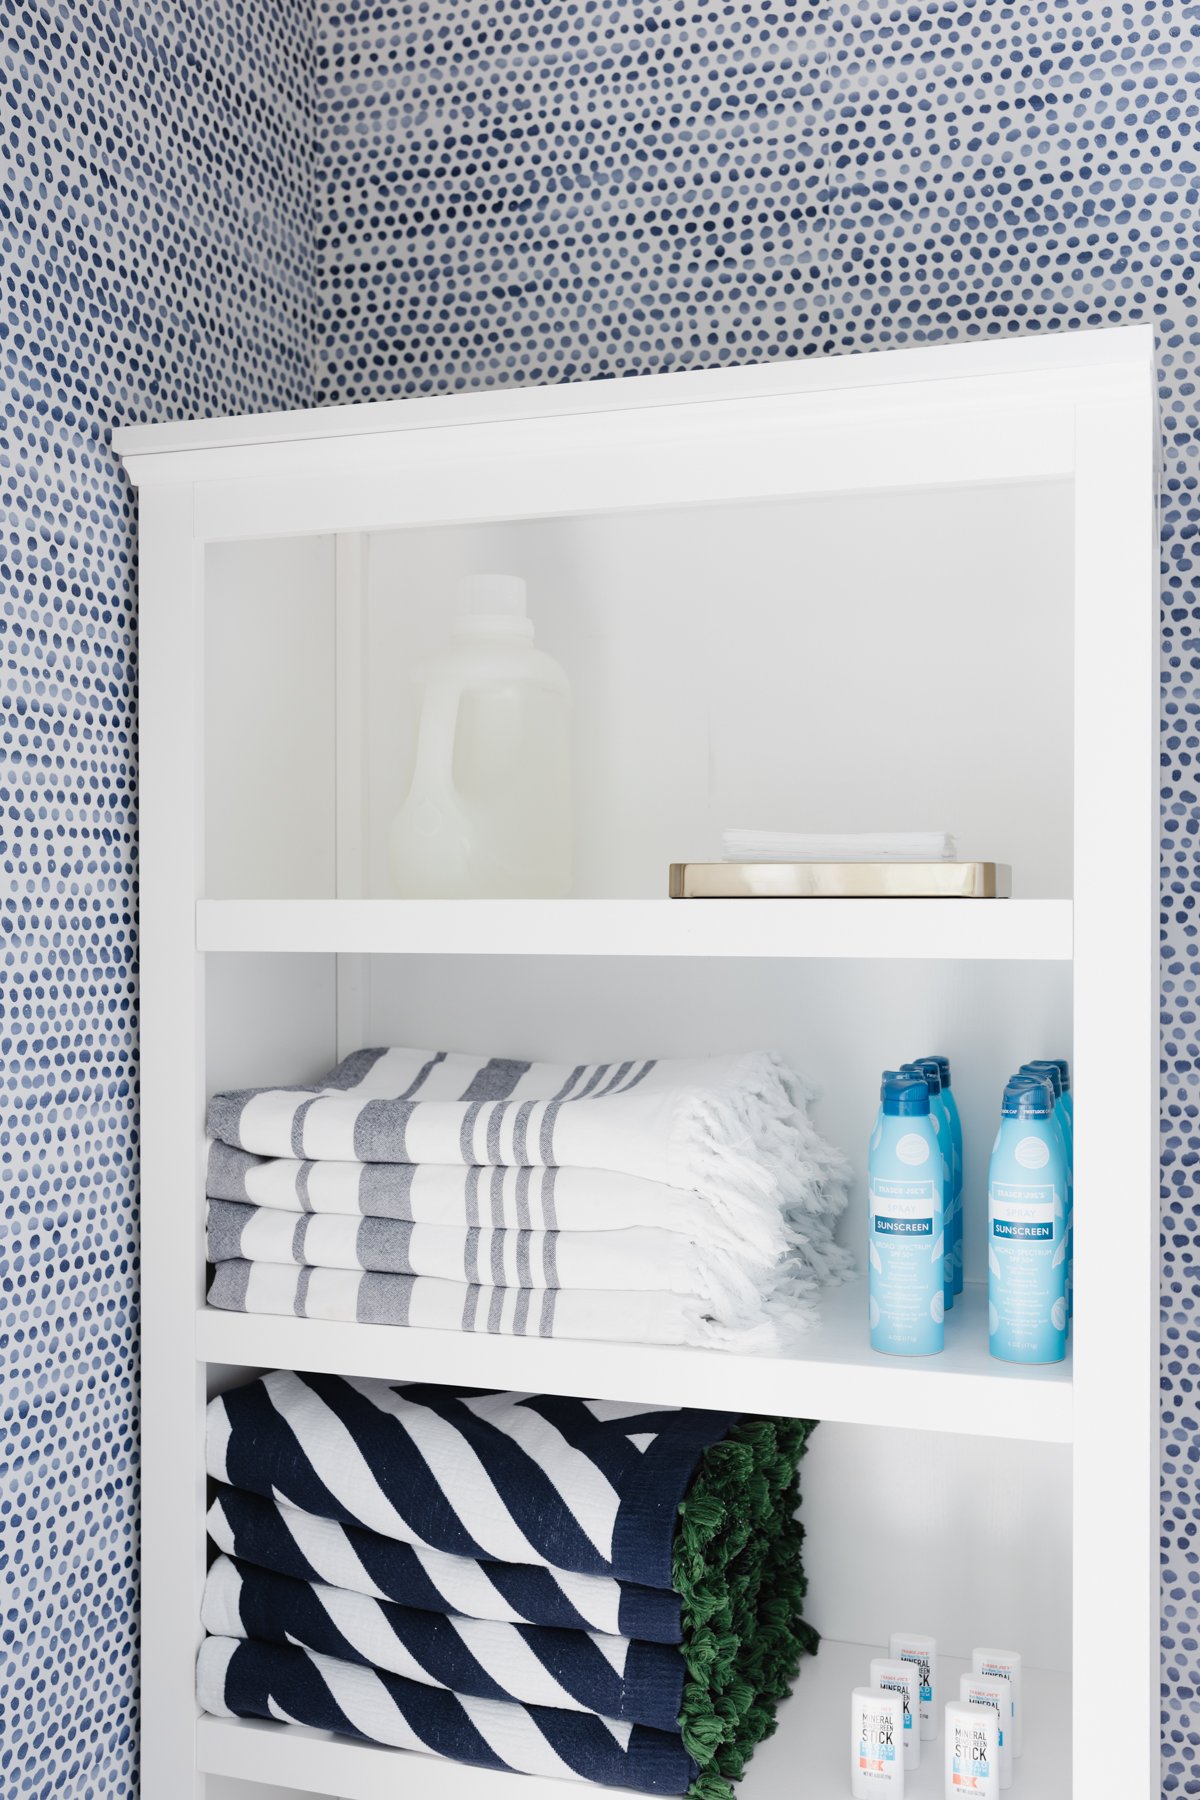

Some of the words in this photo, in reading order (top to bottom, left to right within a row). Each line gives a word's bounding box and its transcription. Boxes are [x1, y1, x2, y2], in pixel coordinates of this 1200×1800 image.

[888, 1204, 916, 1213] SPRAY
[1006, 1208, 1036, 1217] SPRAY
[877, 1221, 929, 1232] SUNSCREEN
[995, 1224, 1049, 1236] SUNSCREEN
[862, 1713, 893, 1725] MINERAL
[862, 1728, 893, 1745] STICK
[955, 1728, 987, 1741] MINERAL
[955, 1744, 987, 1761] STICK
